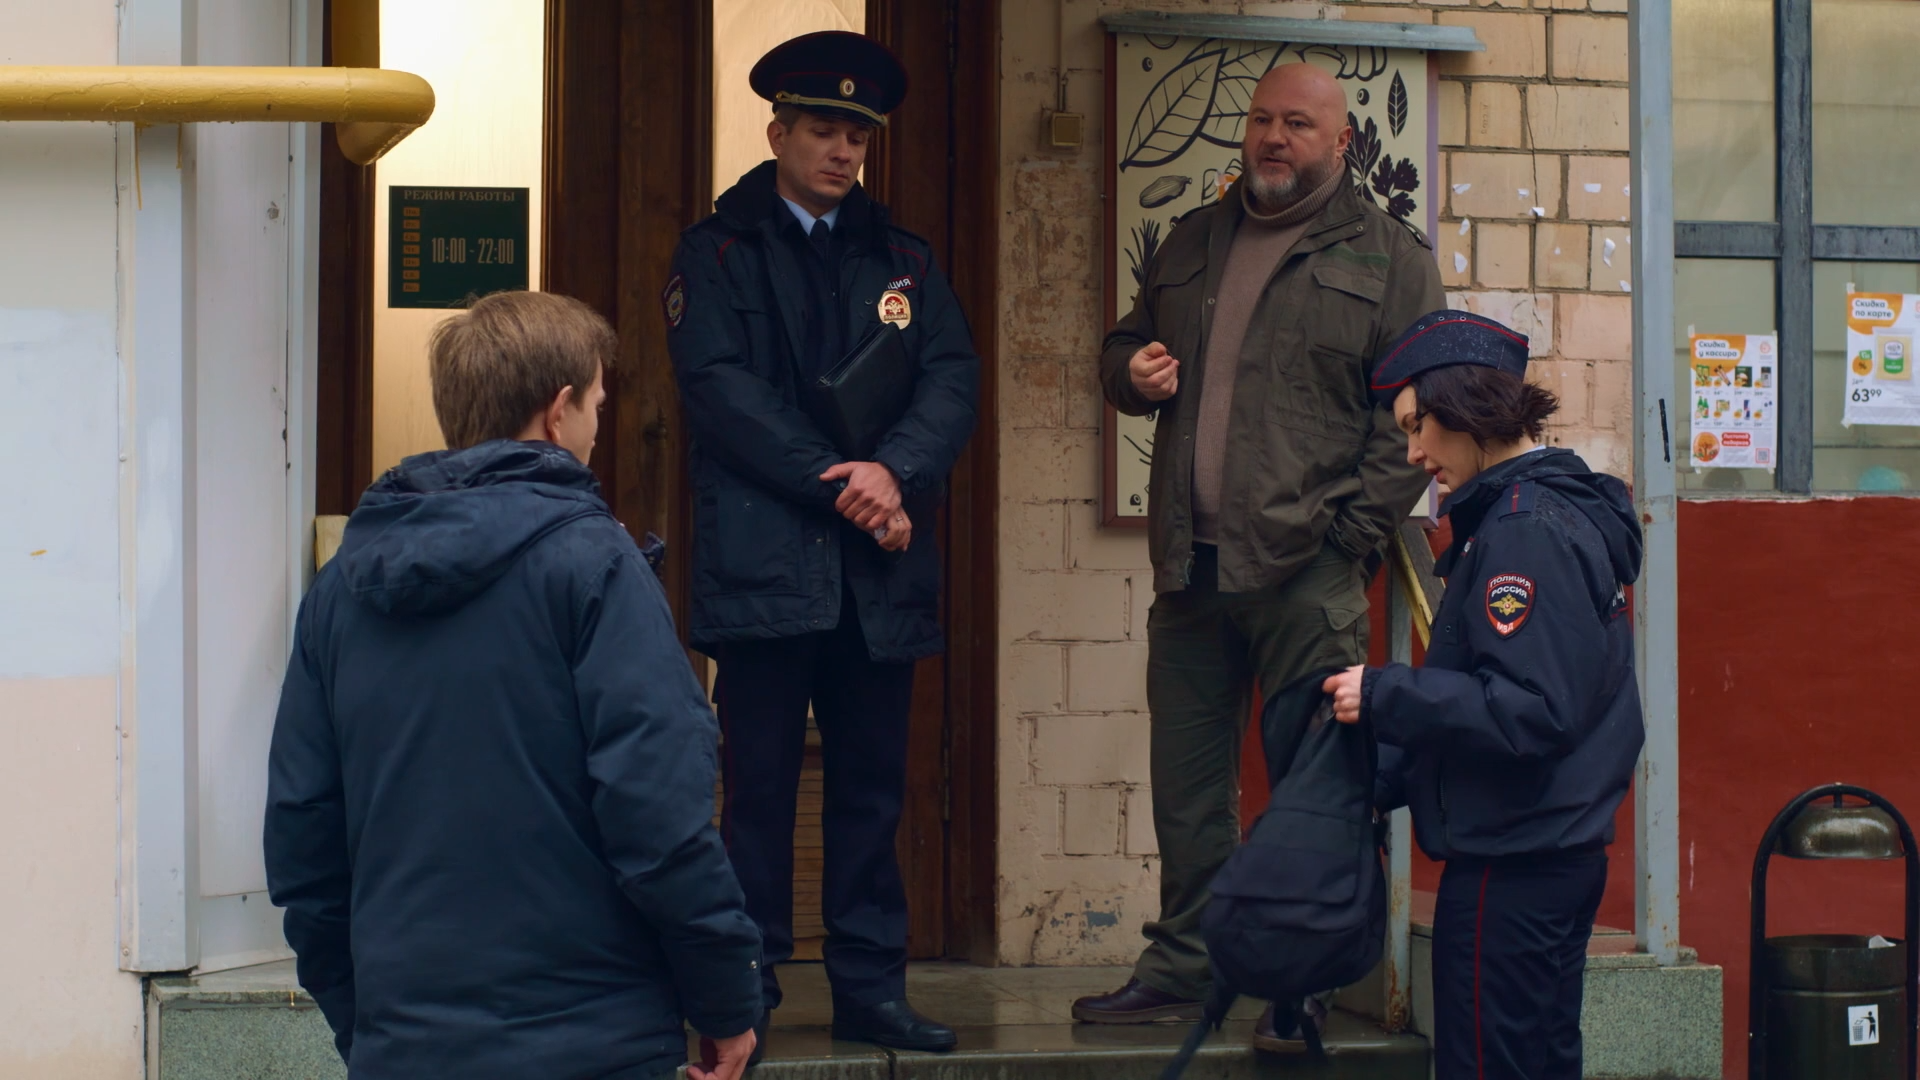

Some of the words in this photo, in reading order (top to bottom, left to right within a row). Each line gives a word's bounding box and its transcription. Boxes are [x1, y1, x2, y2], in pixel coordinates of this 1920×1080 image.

[403, 190, 455, 200] РЕЖИМ
[460, 191, 515, 202] РАБОТЫ
[432, 237, 466, 263] 10:00
[478, 238, 514, 264] 22:00
[1855, 300, 1886, 308] Скидка
[1490, 575, 1531, 590] ПОЛИЦИЯ
[1491, 586, 1527, 598] РОССИЯ
[1497, 621, 1514, 633] МВД
